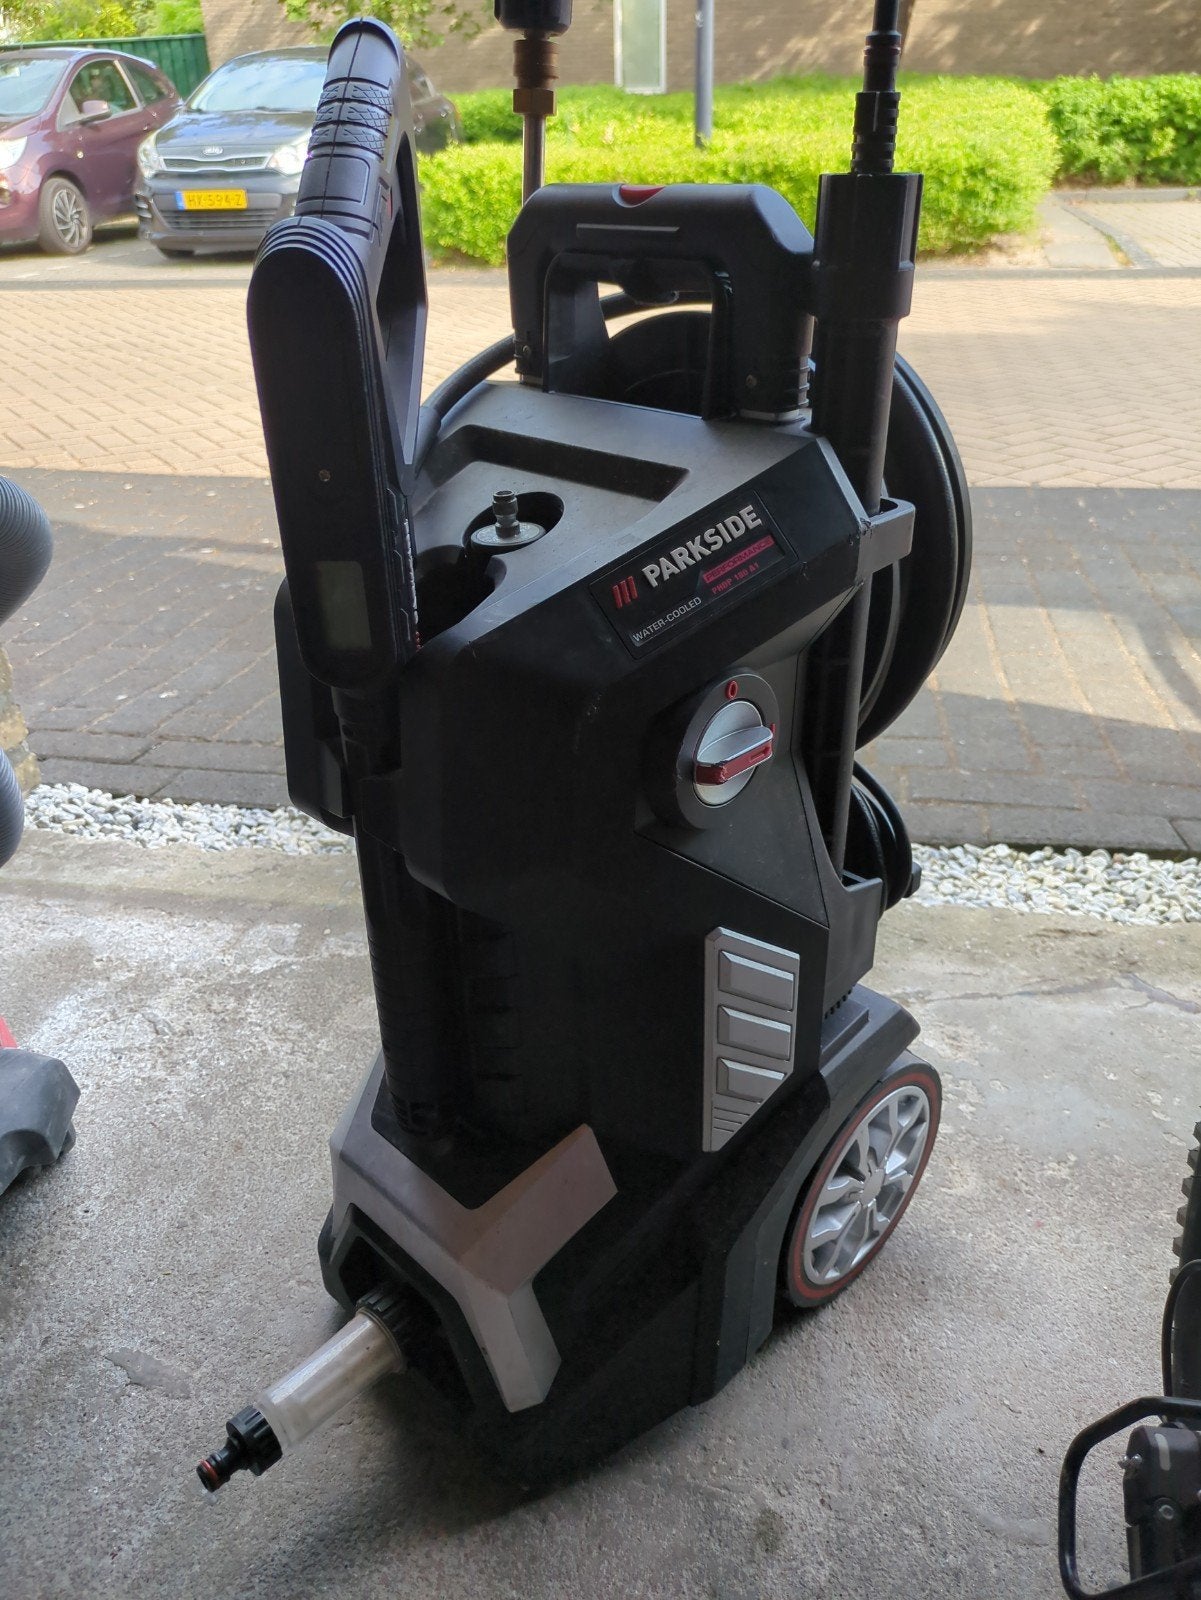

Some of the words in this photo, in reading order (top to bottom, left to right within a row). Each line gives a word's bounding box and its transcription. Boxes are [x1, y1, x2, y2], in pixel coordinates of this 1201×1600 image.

[642, 505, 762, 588] PARKSIDE
[706, 537, 774, 581] PERFORMANCE
[632, 596, 702, 642] WATER-COOLED
